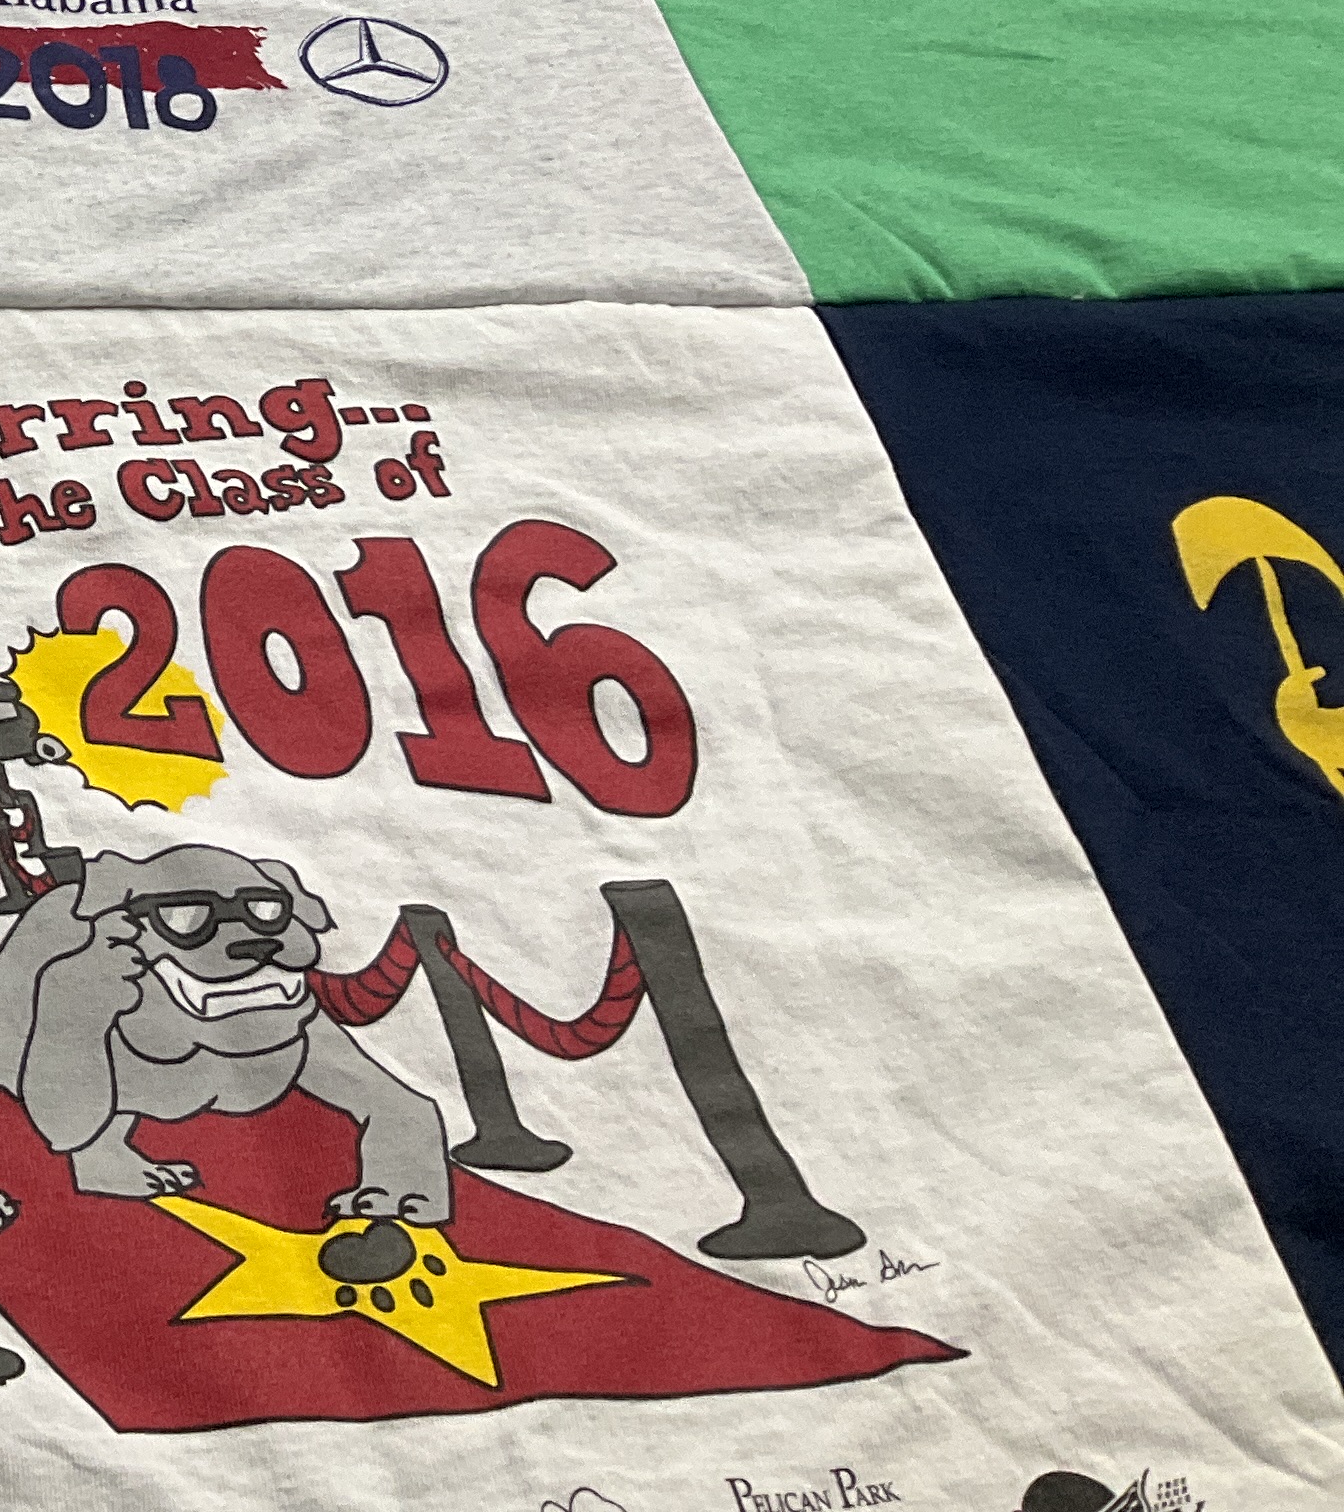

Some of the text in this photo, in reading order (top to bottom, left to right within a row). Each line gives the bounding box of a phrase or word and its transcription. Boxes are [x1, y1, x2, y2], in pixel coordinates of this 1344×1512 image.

[117, 456, 346, 524] Class
[374, 428, 453, 502] of
[52, 517, 702, 820] 2016
[725, 1467, 902, 1512] PELICAN PARK
